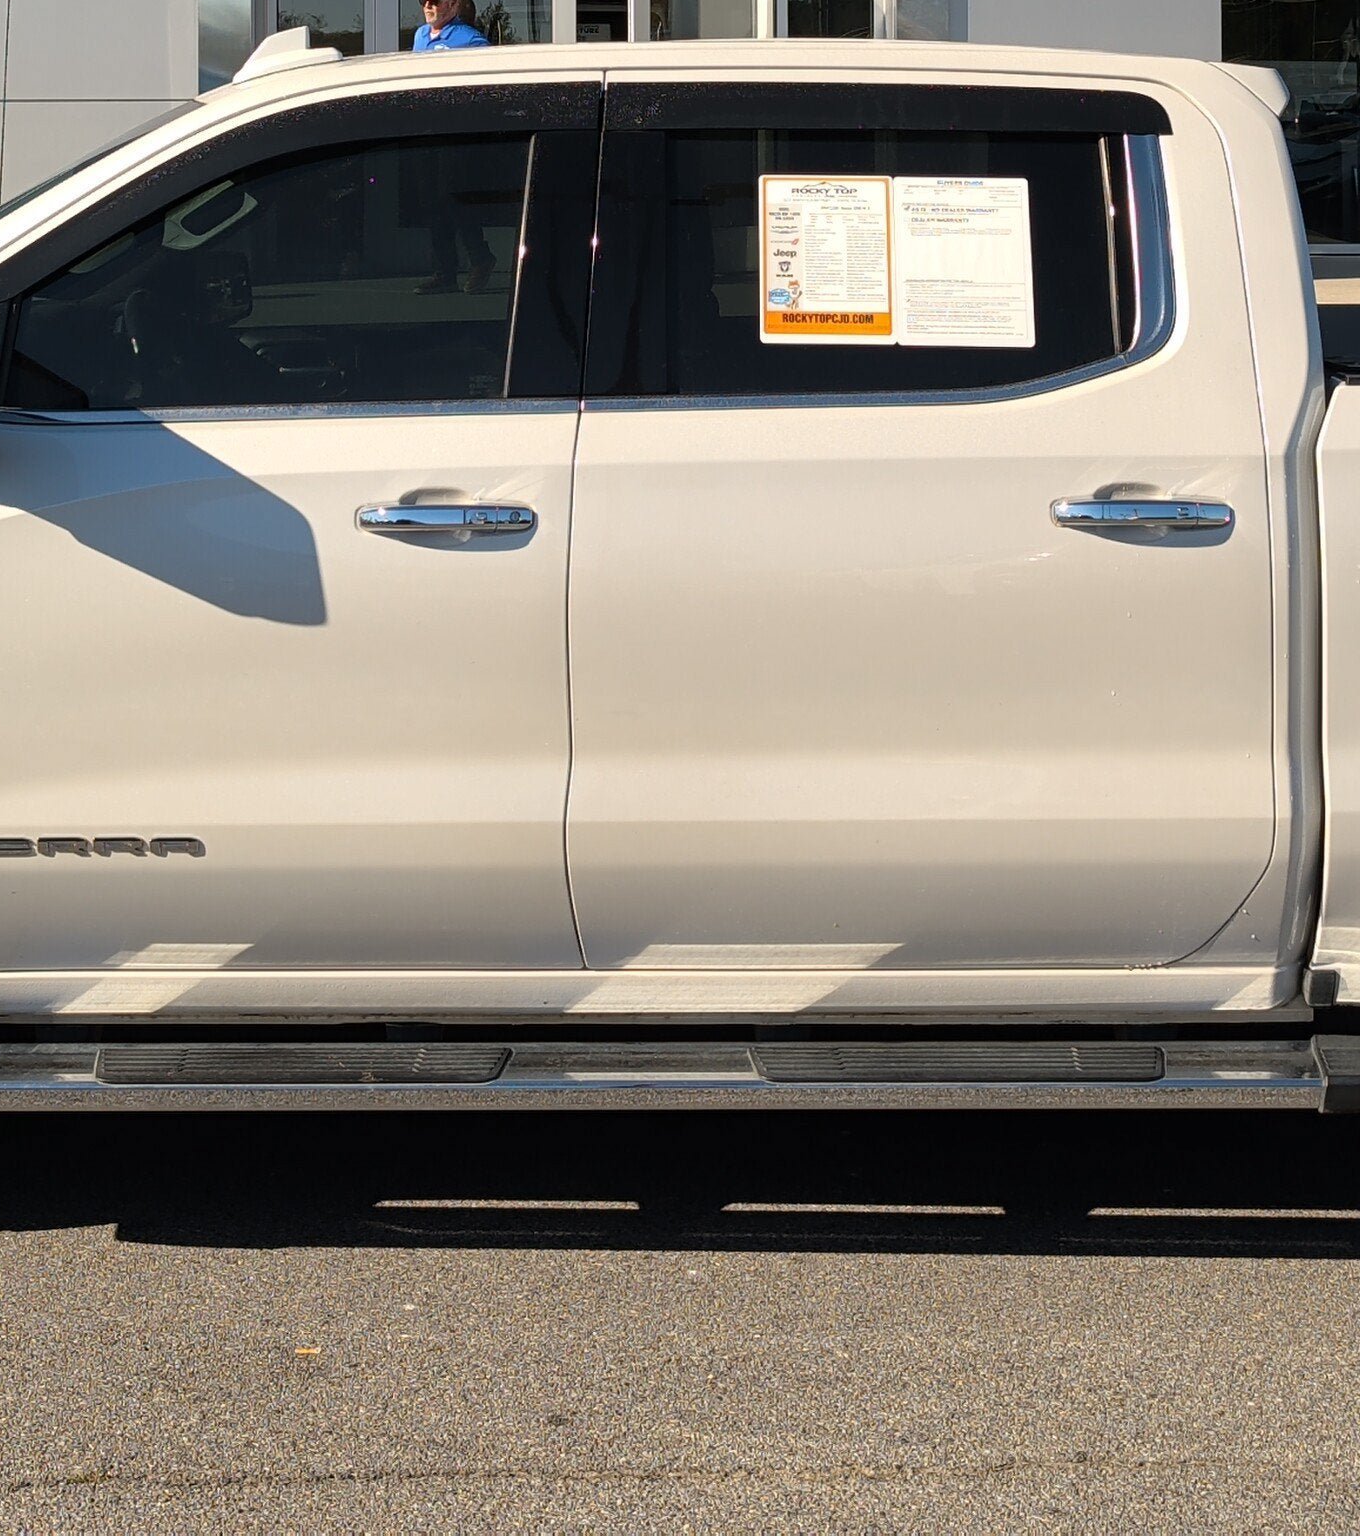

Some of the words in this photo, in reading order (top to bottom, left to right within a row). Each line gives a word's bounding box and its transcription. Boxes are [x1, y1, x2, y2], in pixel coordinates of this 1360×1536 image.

[791, 187, 831, 197] ROCKY
[833, 187, 858, 195] TOP
[773, 249, 797, 258] Jeep
[782, 313, 874, 324] ROCKYTOPCJD.COM
